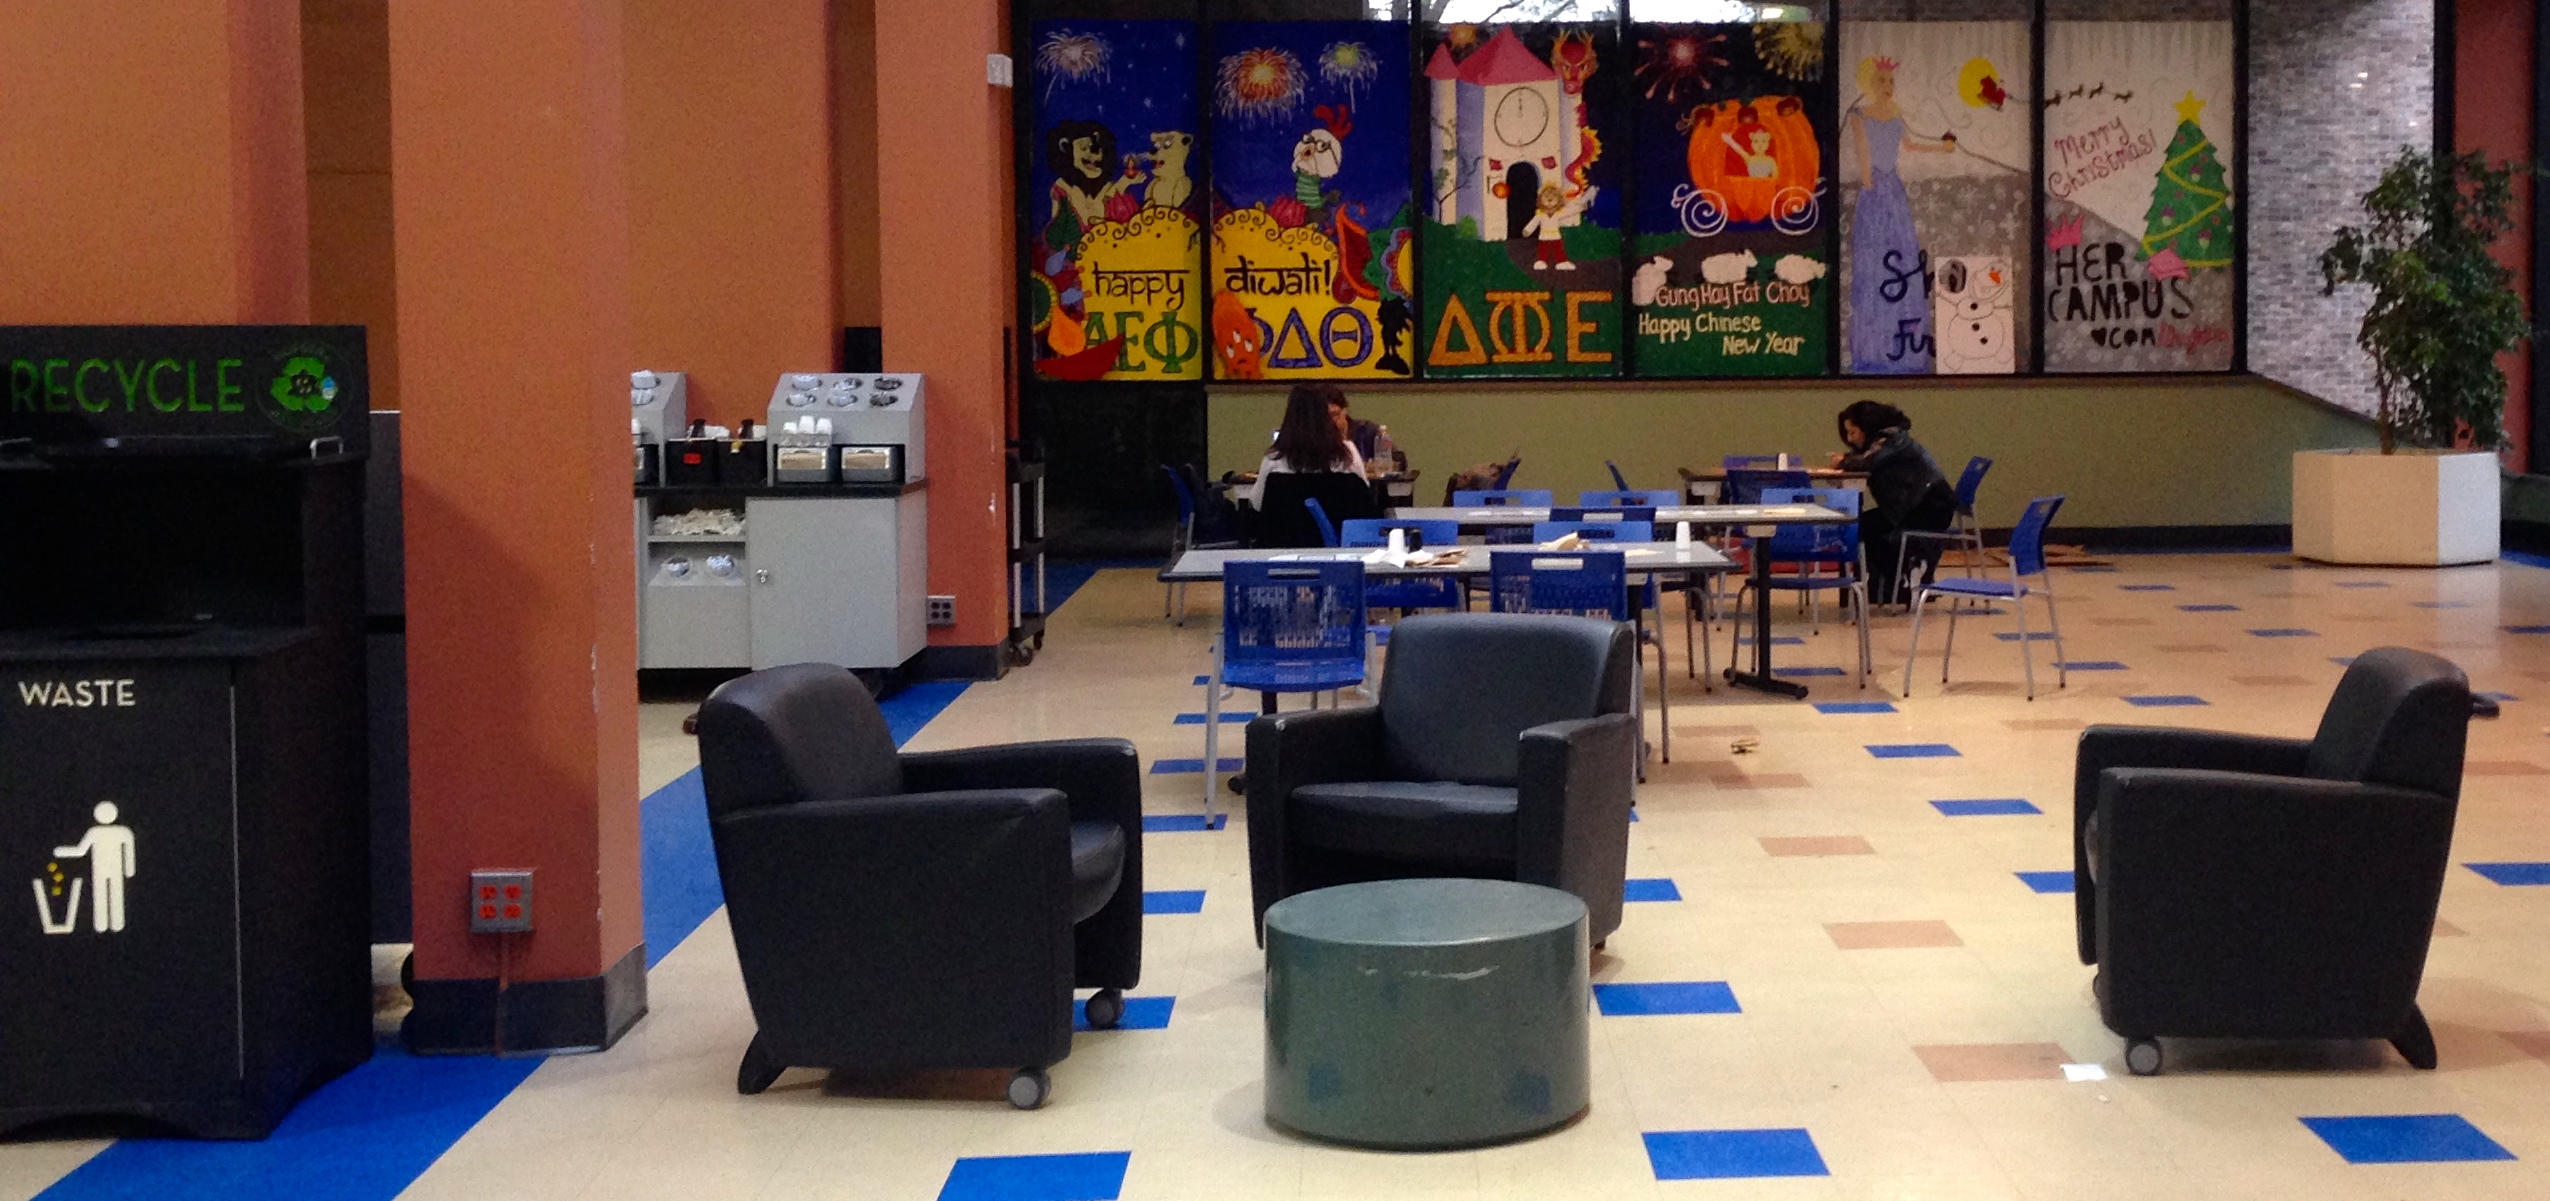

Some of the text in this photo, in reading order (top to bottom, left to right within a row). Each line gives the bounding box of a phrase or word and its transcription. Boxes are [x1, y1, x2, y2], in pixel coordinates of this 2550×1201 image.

[2054, 116, 2130, 168] Merry
[1092, 261, 1190, 311] happy
[1224, 252, 1331, 296] diwali!
[2056, 242, 2128, 286] HER
[1656, 285, 1700, 311] Gung
[1701, 284, 1730, 309] Hay
[1733, 281, 1761, 306] Fat
[2048, 275, 2194, 322] CAMPUS
[1638, 311, 1762, 344] Happy Chinese
[1722, 331, 1806, 356] New Year
[11, 358, 245, 413] RECYCLE
[18, 679, 136, 707] WASTE
